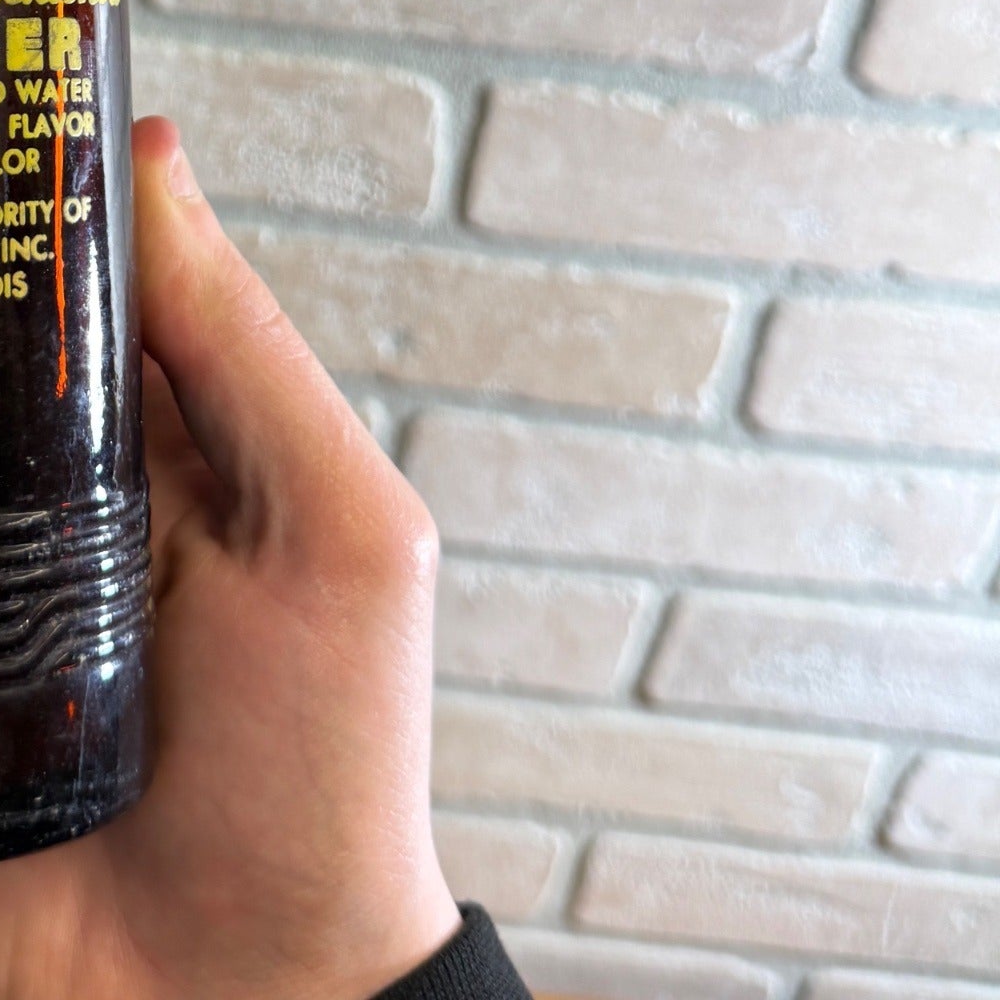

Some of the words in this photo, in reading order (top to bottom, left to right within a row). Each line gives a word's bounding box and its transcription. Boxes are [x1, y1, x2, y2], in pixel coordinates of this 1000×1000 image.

[15, 78, 93, 104] WATER
[9, 111, 96, 140] FLAVOR
[63, 196, 92, 224] OF
[1, 234, 55, 263] INC.
